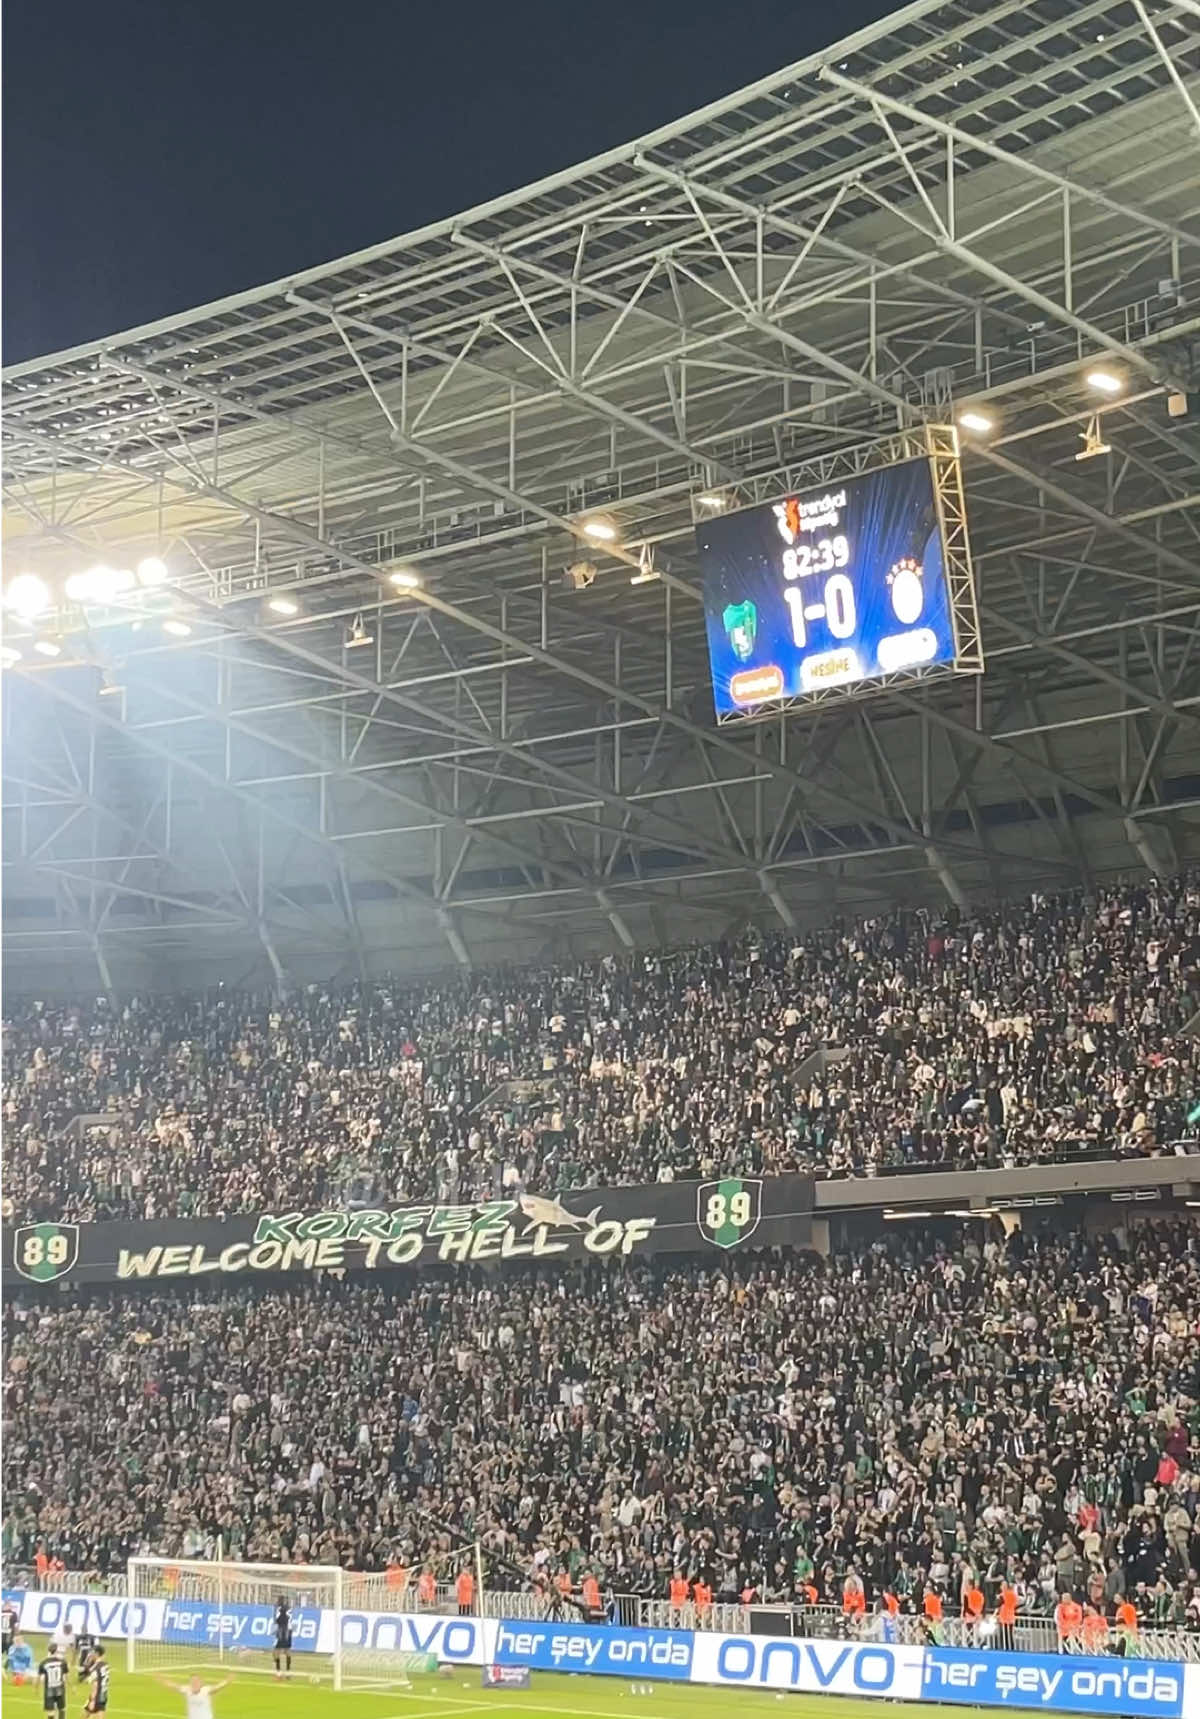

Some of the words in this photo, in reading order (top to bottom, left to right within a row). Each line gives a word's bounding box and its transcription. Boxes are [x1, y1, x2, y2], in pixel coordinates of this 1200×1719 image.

[782, 535, 850, 581] 82:39
[783, 574, 856, 648] 1-0
[705, 1191, 751, 1229] 89
[23, 1235, 68, 1266] 89
[116, 1236, 346, 1278] WELCOME
[357, 1232, 424, 1269] TO
[437, 1222, 569, 1262] HELL
[583, 1216, 656, 1254] OF
[164, 1604, 204, 1632] her
[497, 1624, 548, 1656] her
[551, 1636, 605, 1666] şey
[607, 1637, 690, 1666] on'da
[717, 1637, 896, 1692] onvo
[923, 1654, 989, 1688] her
[995, 1665, 1062, 1700] şey
[1071, 1666, 1178, 1702] on'da
